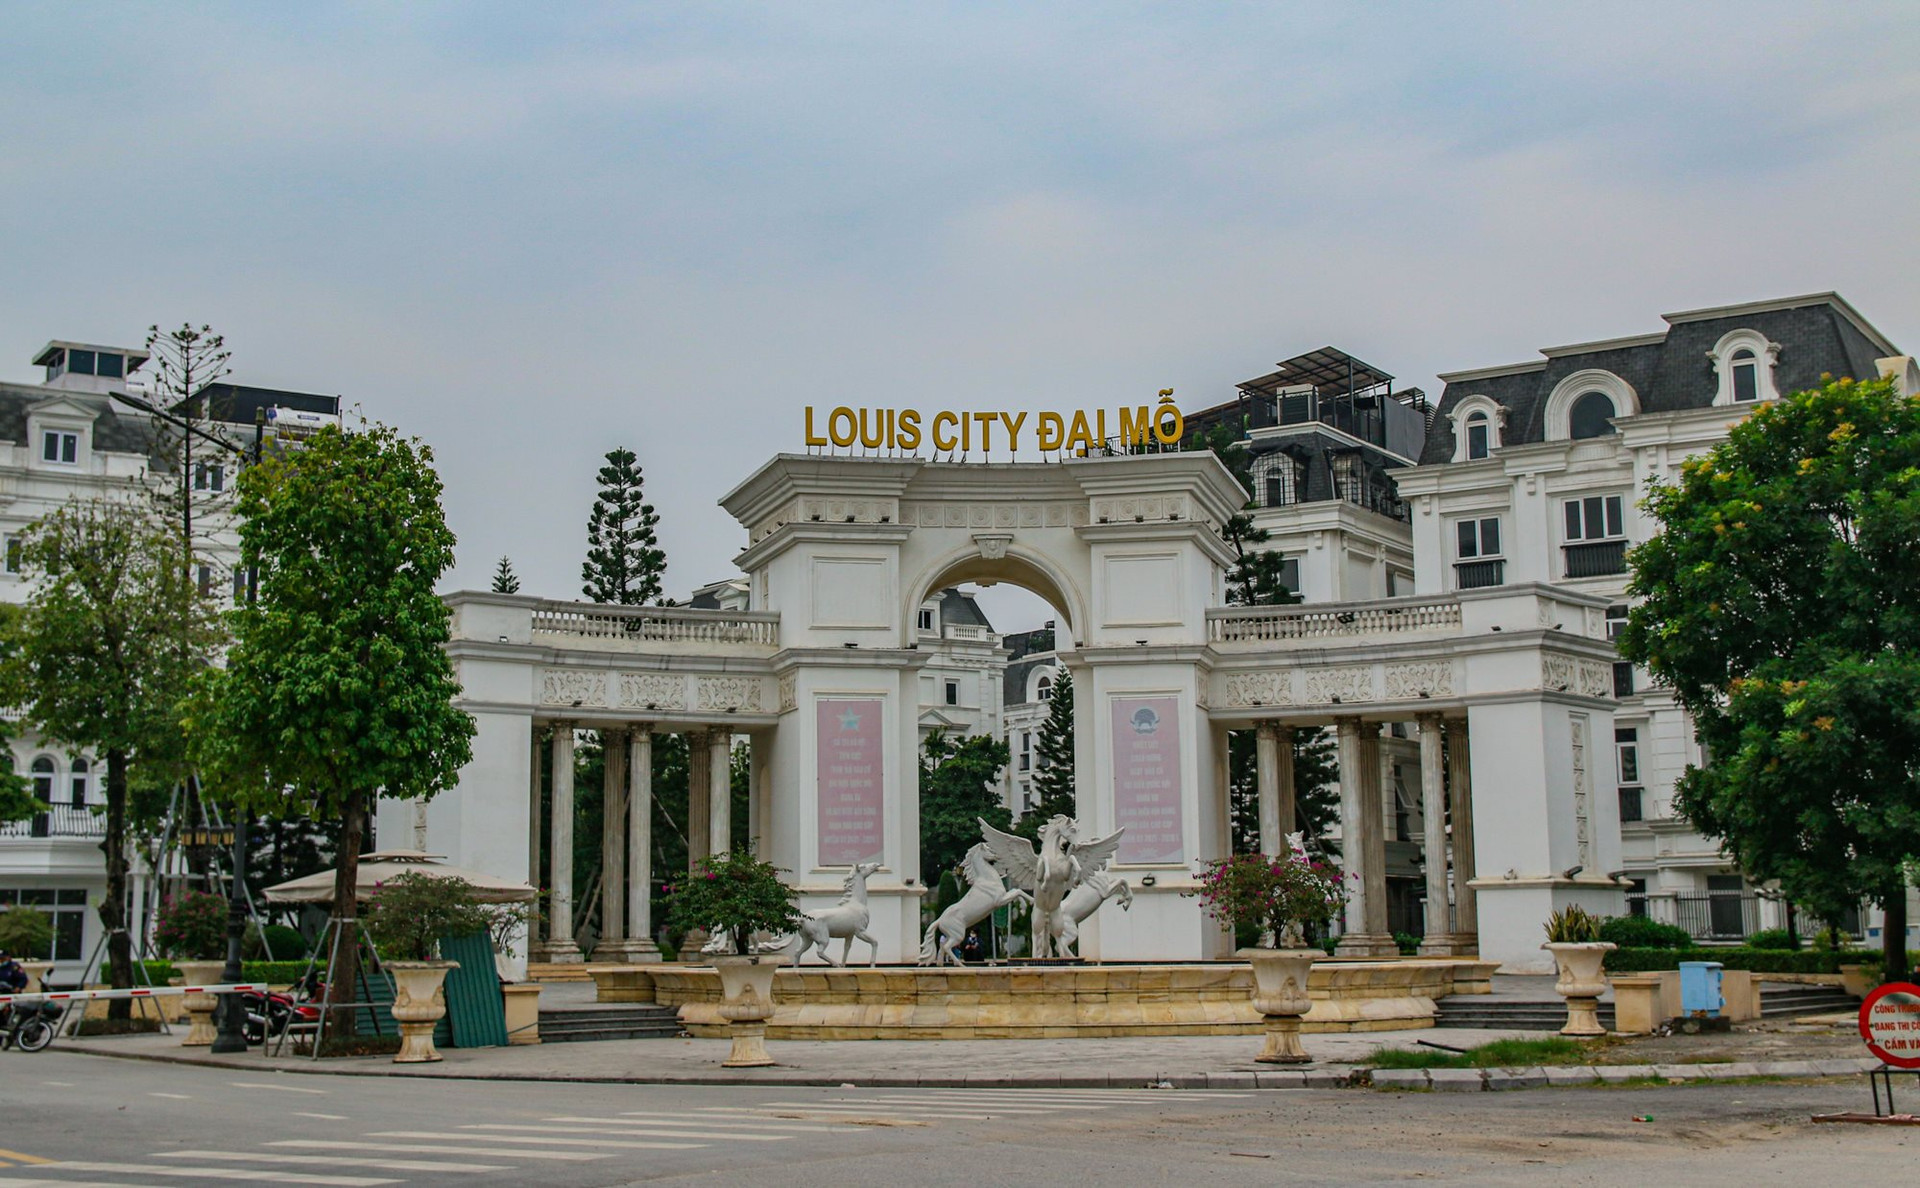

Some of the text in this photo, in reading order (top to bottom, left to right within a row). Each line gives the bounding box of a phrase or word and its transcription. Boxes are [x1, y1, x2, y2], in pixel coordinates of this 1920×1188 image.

[805, 388, 1185, 457] LOUIS CITY ĐẠI MỖ
[1874, 1004, 1896, 1014] CÔNG
[1897, 1021, 1910, 1031] THI
